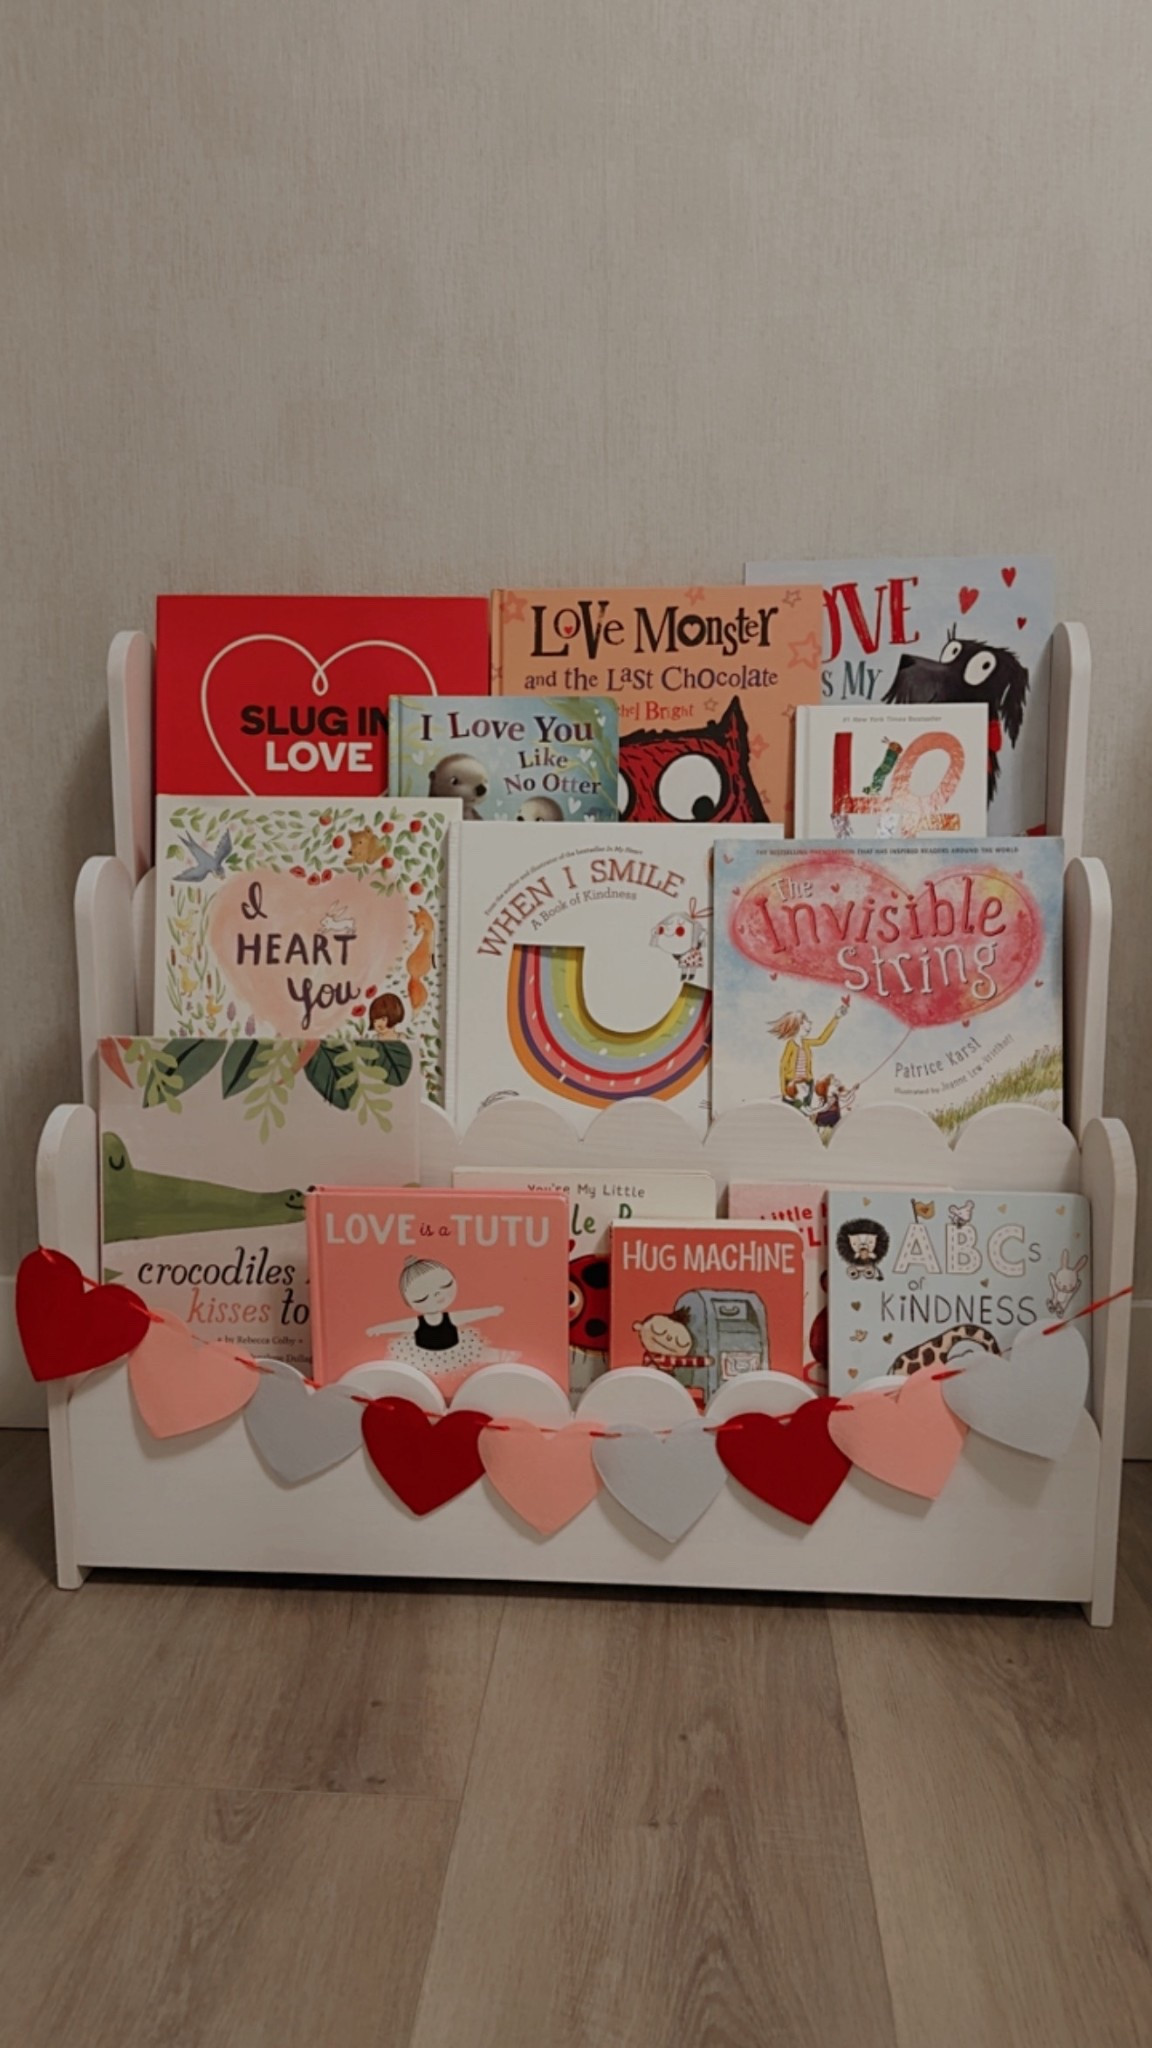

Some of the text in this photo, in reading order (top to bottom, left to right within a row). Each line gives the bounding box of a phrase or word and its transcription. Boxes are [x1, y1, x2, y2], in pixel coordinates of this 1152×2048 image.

[634, 606, 778, 656] Monster
[821, 576, 920, 664] OVE
[525, 665, 779, 692] and the Last Chocolate
[821, 669, 834, 698] S
[240, 705, 389, 736] SLUG IN
[421, 711, 595, 743] I Love You
[645, 700, 695, 721] Bright
[265, 741, 374, 773] LOVE
[519, 750, 569, 770] Like
[504, 773, 602, 796] No Otter
[772, 877, 814, 902] The
[477, 858, 685, 957] WHEN I SMILE
[531, 886, 637, 931] A Book of Kindness
[755, 876, 1007, 954] Invisible
[236, 932, 358, 966] HEART
[837, 941, 999, 1001] String
[895, 1036, 982, 1079] Patrice Karst
[577, 1183, 597, 1200] My
[602, 1184, 646, 1199] Little
[325, 1212, 416, 1246] LOVE
[418, 1221, 435, 1238] is
[437, 1224, 451, 1238] a
[450, 1213, 551, 1249] TUTU
[137, 1246, 297, 1286] crocodiles
[622, 1240, 796, 1275] HUG MACHINE
[907, 1276, 928, 1292] of
[186, 1286, 310, 1326] kisses to
